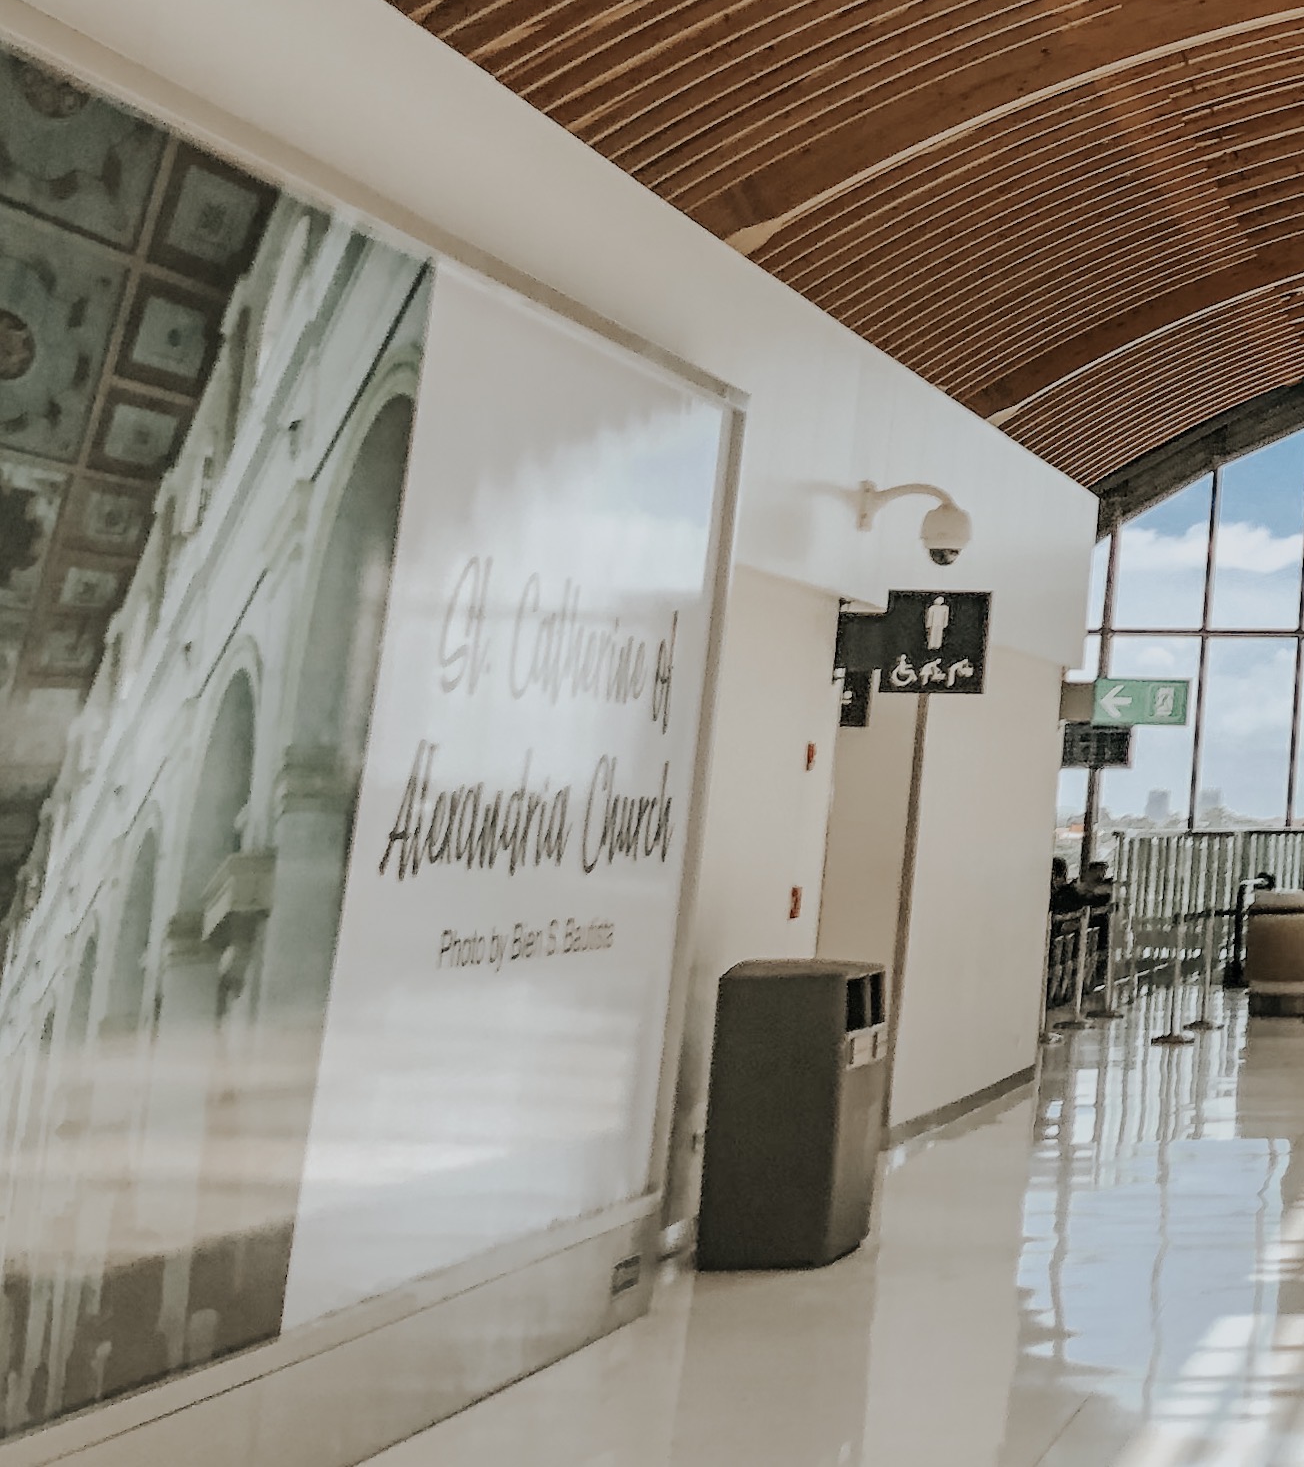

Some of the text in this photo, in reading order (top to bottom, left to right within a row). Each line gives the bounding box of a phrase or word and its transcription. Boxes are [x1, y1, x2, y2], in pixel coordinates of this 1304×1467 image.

[508, 570, 649, 707] Catherine
[652, 609, 679, 735] of
[378, 738, 675, 883] Alexandria Church
[437, 927, 486, 970] Photo
[488, 925, 508, 974] by
